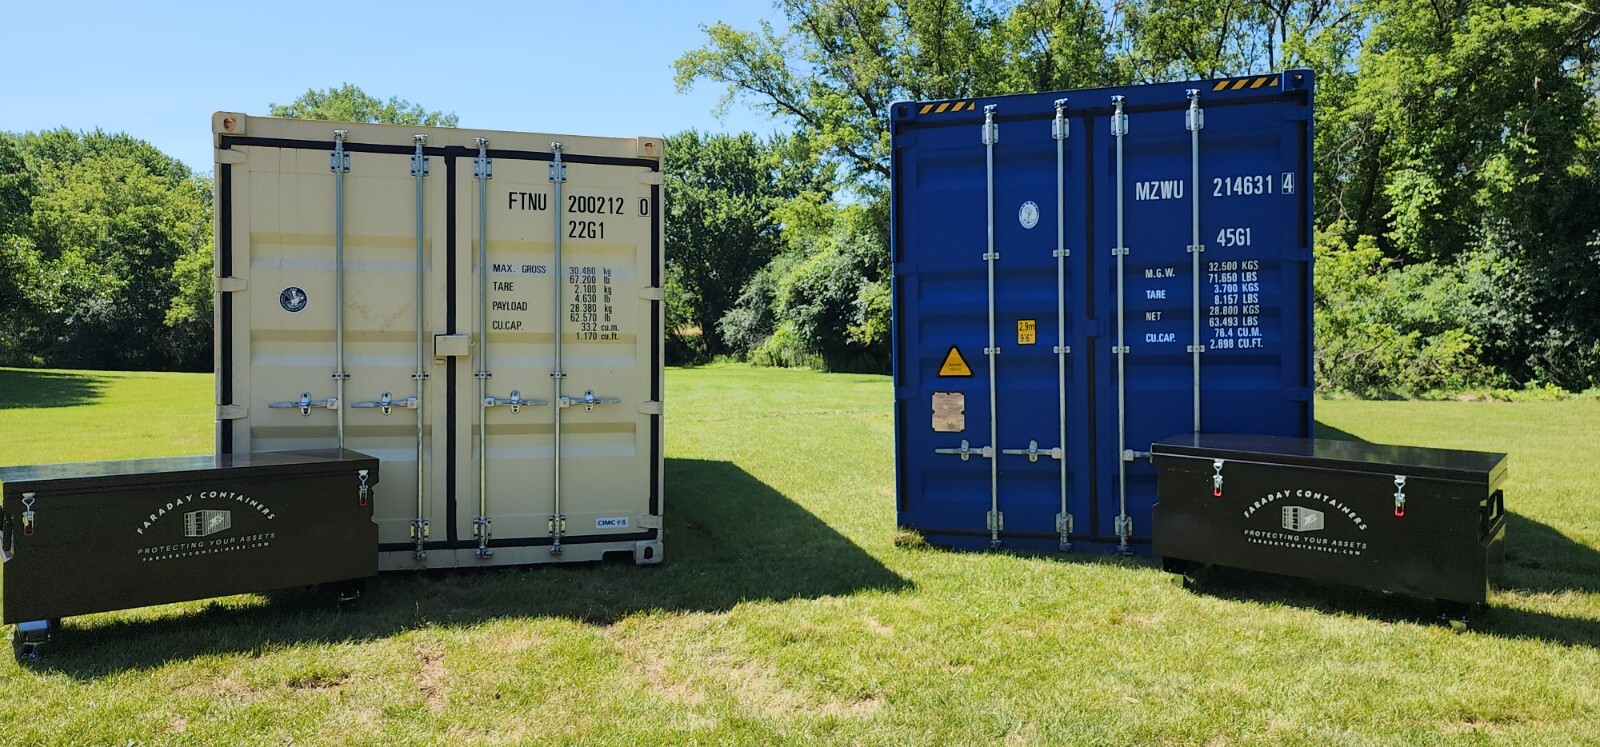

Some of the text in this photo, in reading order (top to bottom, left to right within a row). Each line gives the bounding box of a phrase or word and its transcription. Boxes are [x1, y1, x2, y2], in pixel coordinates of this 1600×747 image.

[1135, 173, 1293, 201] MZWU 214631 4
[508, 192, 648, 215] FTNU 200212 0
[568, 220, 604, 239] 22G1
[1216, 227, 1251, 247] 45G1
[492, 264, 516, 273] MAX.
[521, 265, 546, 274] GROSS
[603, 267, 611, 276] kg
[1145, 260, 1259, 279] M.G.W. 32.500 KGS
[1208, 272, 1257, 283] 71.650 LBS
[569, 276, 596, 284] 67.200
[493, 282, 612, 295] TARE 2.100 kg
[1146, 283, 1259, 300] TARE 3.700 KGS
[575, 294, 596, 302] 4.630
[1214, 294, 1258, 305] 8.157 LBS
[492, 301, 612, 314] PAYLOAD 28.380 kg
[1145, 305, 1260, 321] NET 28.800 KGS
[492, 321, 523, 331] CU.CAP.
[581, 323, 597, 331] 33.2
[570, 314, 597, 322] 62.570
[1209, 316, 1258, 327] 63.493 LBS
[1145, 327, 1262, 343] CU.CAP. 76.4 CU.M.
[1210, 338, 1263, 349] 2.698 CU.FT.
[136, 491, 276, 535] FARADAY CONTAINERS
[1243, 489, 1368, 531] FARADAY CONTAINERS
[137, 532, 276, 555] PROTECTING YOUR ASSETS
[1244, 529, 1367, 549] PROTECTING YOUR ASSETS
